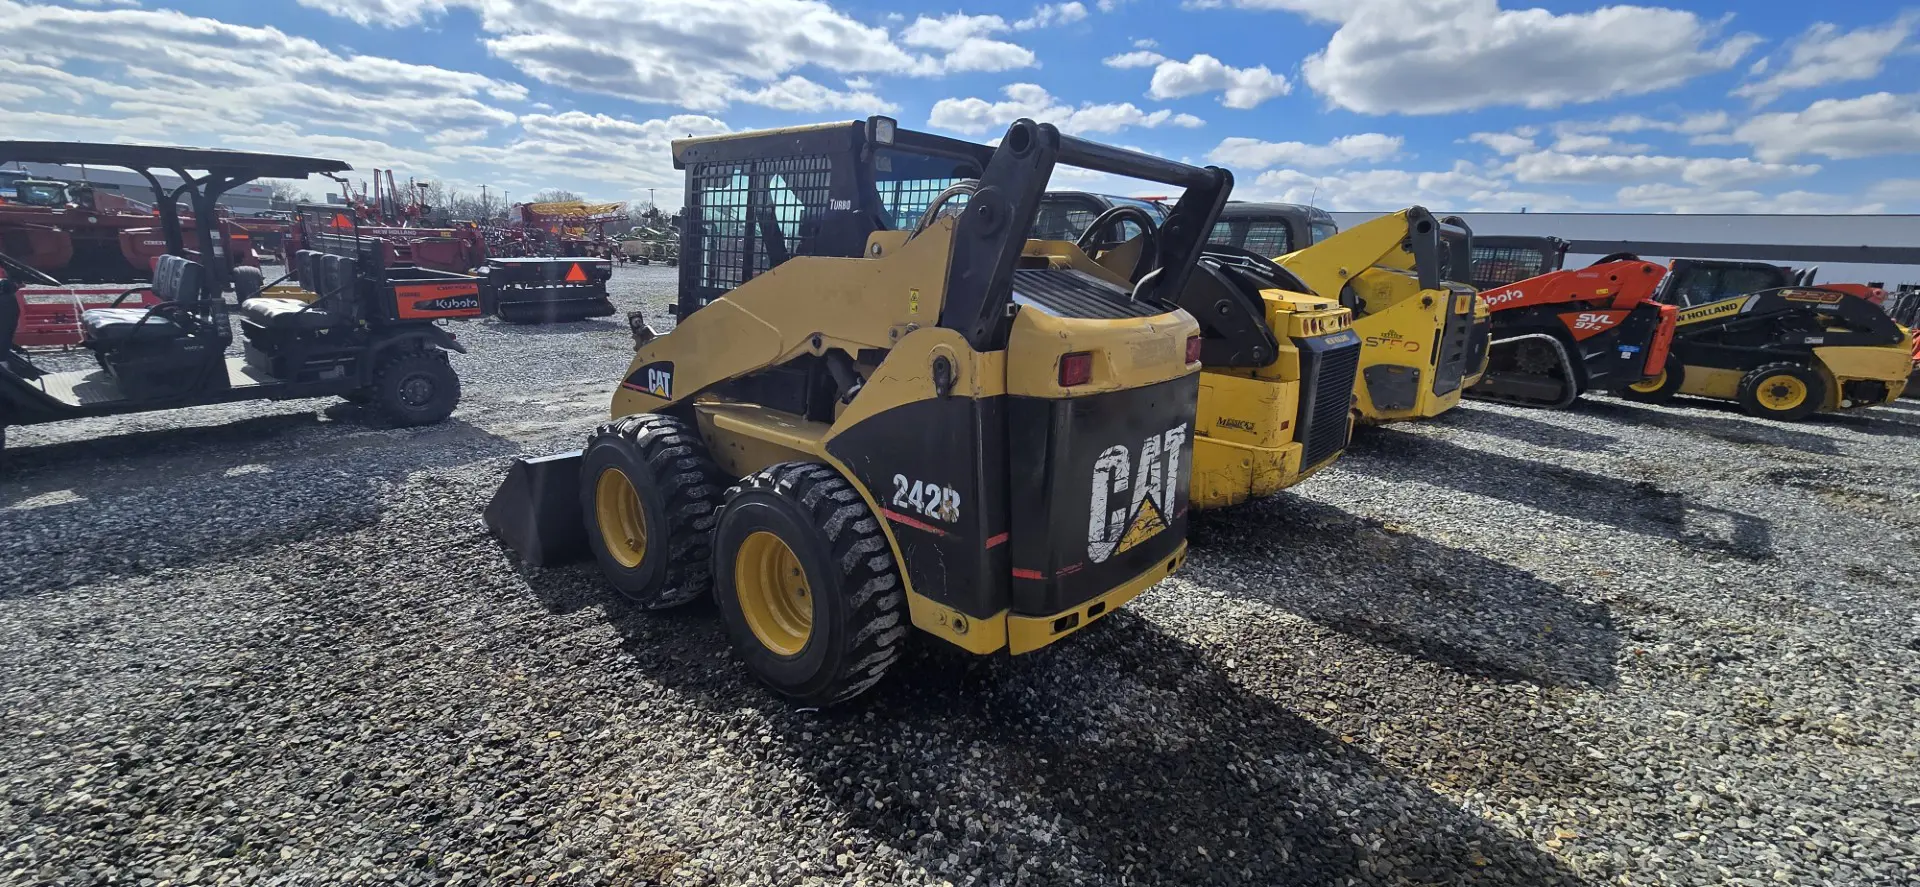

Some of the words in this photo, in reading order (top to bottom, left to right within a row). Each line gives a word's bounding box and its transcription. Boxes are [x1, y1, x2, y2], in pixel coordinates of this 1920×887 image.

[830, 198, 851, 210] TURBO
[436, 298, 478, 309] Kubota
[1483, 289, 1523, 305] bota
[1576, 313, 1614, 324] SVL
[1687, 302, 1738, 320] HOLLAND
[648, 367, 670, 398] CAT
[892, 473, 961, 523] 242B
[1087, 422, 1187, 564] CAT
